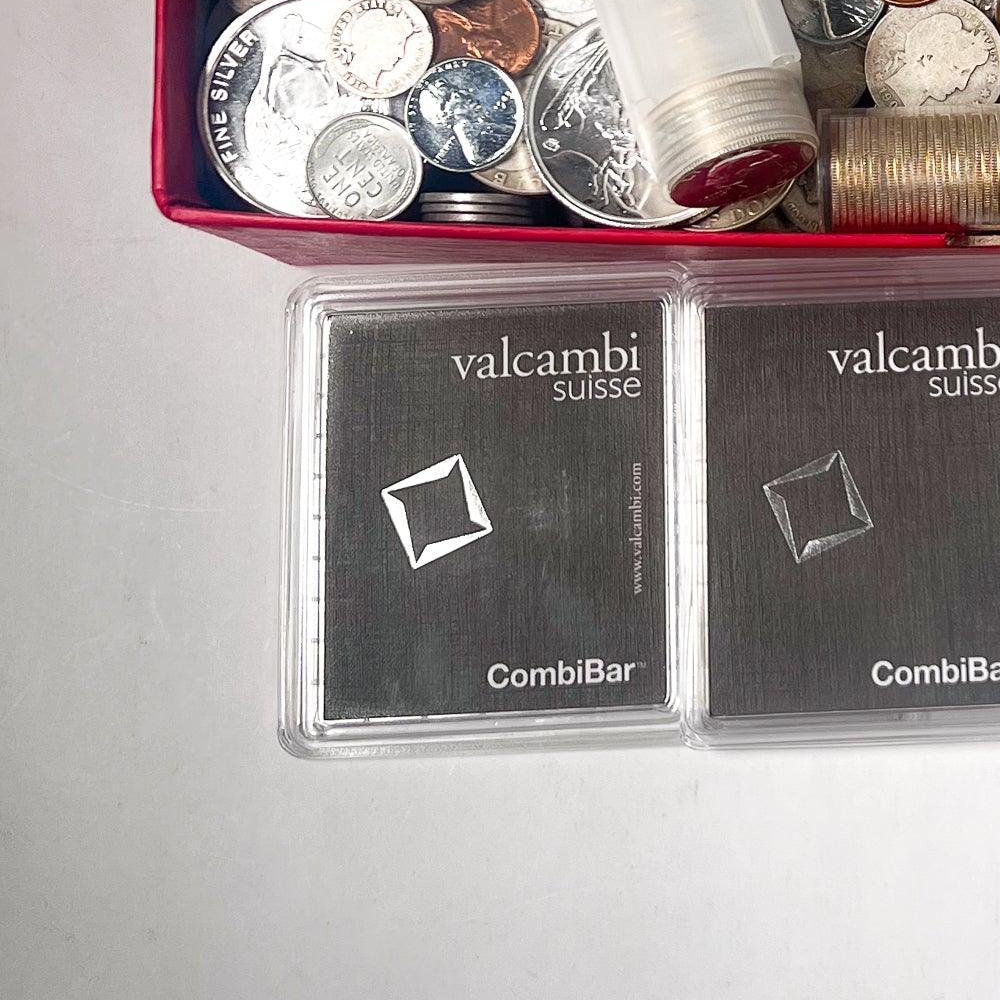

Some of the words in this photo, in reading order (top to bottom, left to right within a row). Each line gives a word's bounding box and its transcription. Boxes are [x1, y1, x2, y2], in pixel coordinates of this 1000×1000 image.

[210, 29, 260, 102] SILVER
[210, 110, 239, 164] FINE
[323, 164, 361, 208] ONE
[335, 150, 383, 198] CENT
[451, 330, 641, 380] valcambi
[553, 375, 642, 402] suisse
[628, 461, 644, 596] www.valcambi.com
